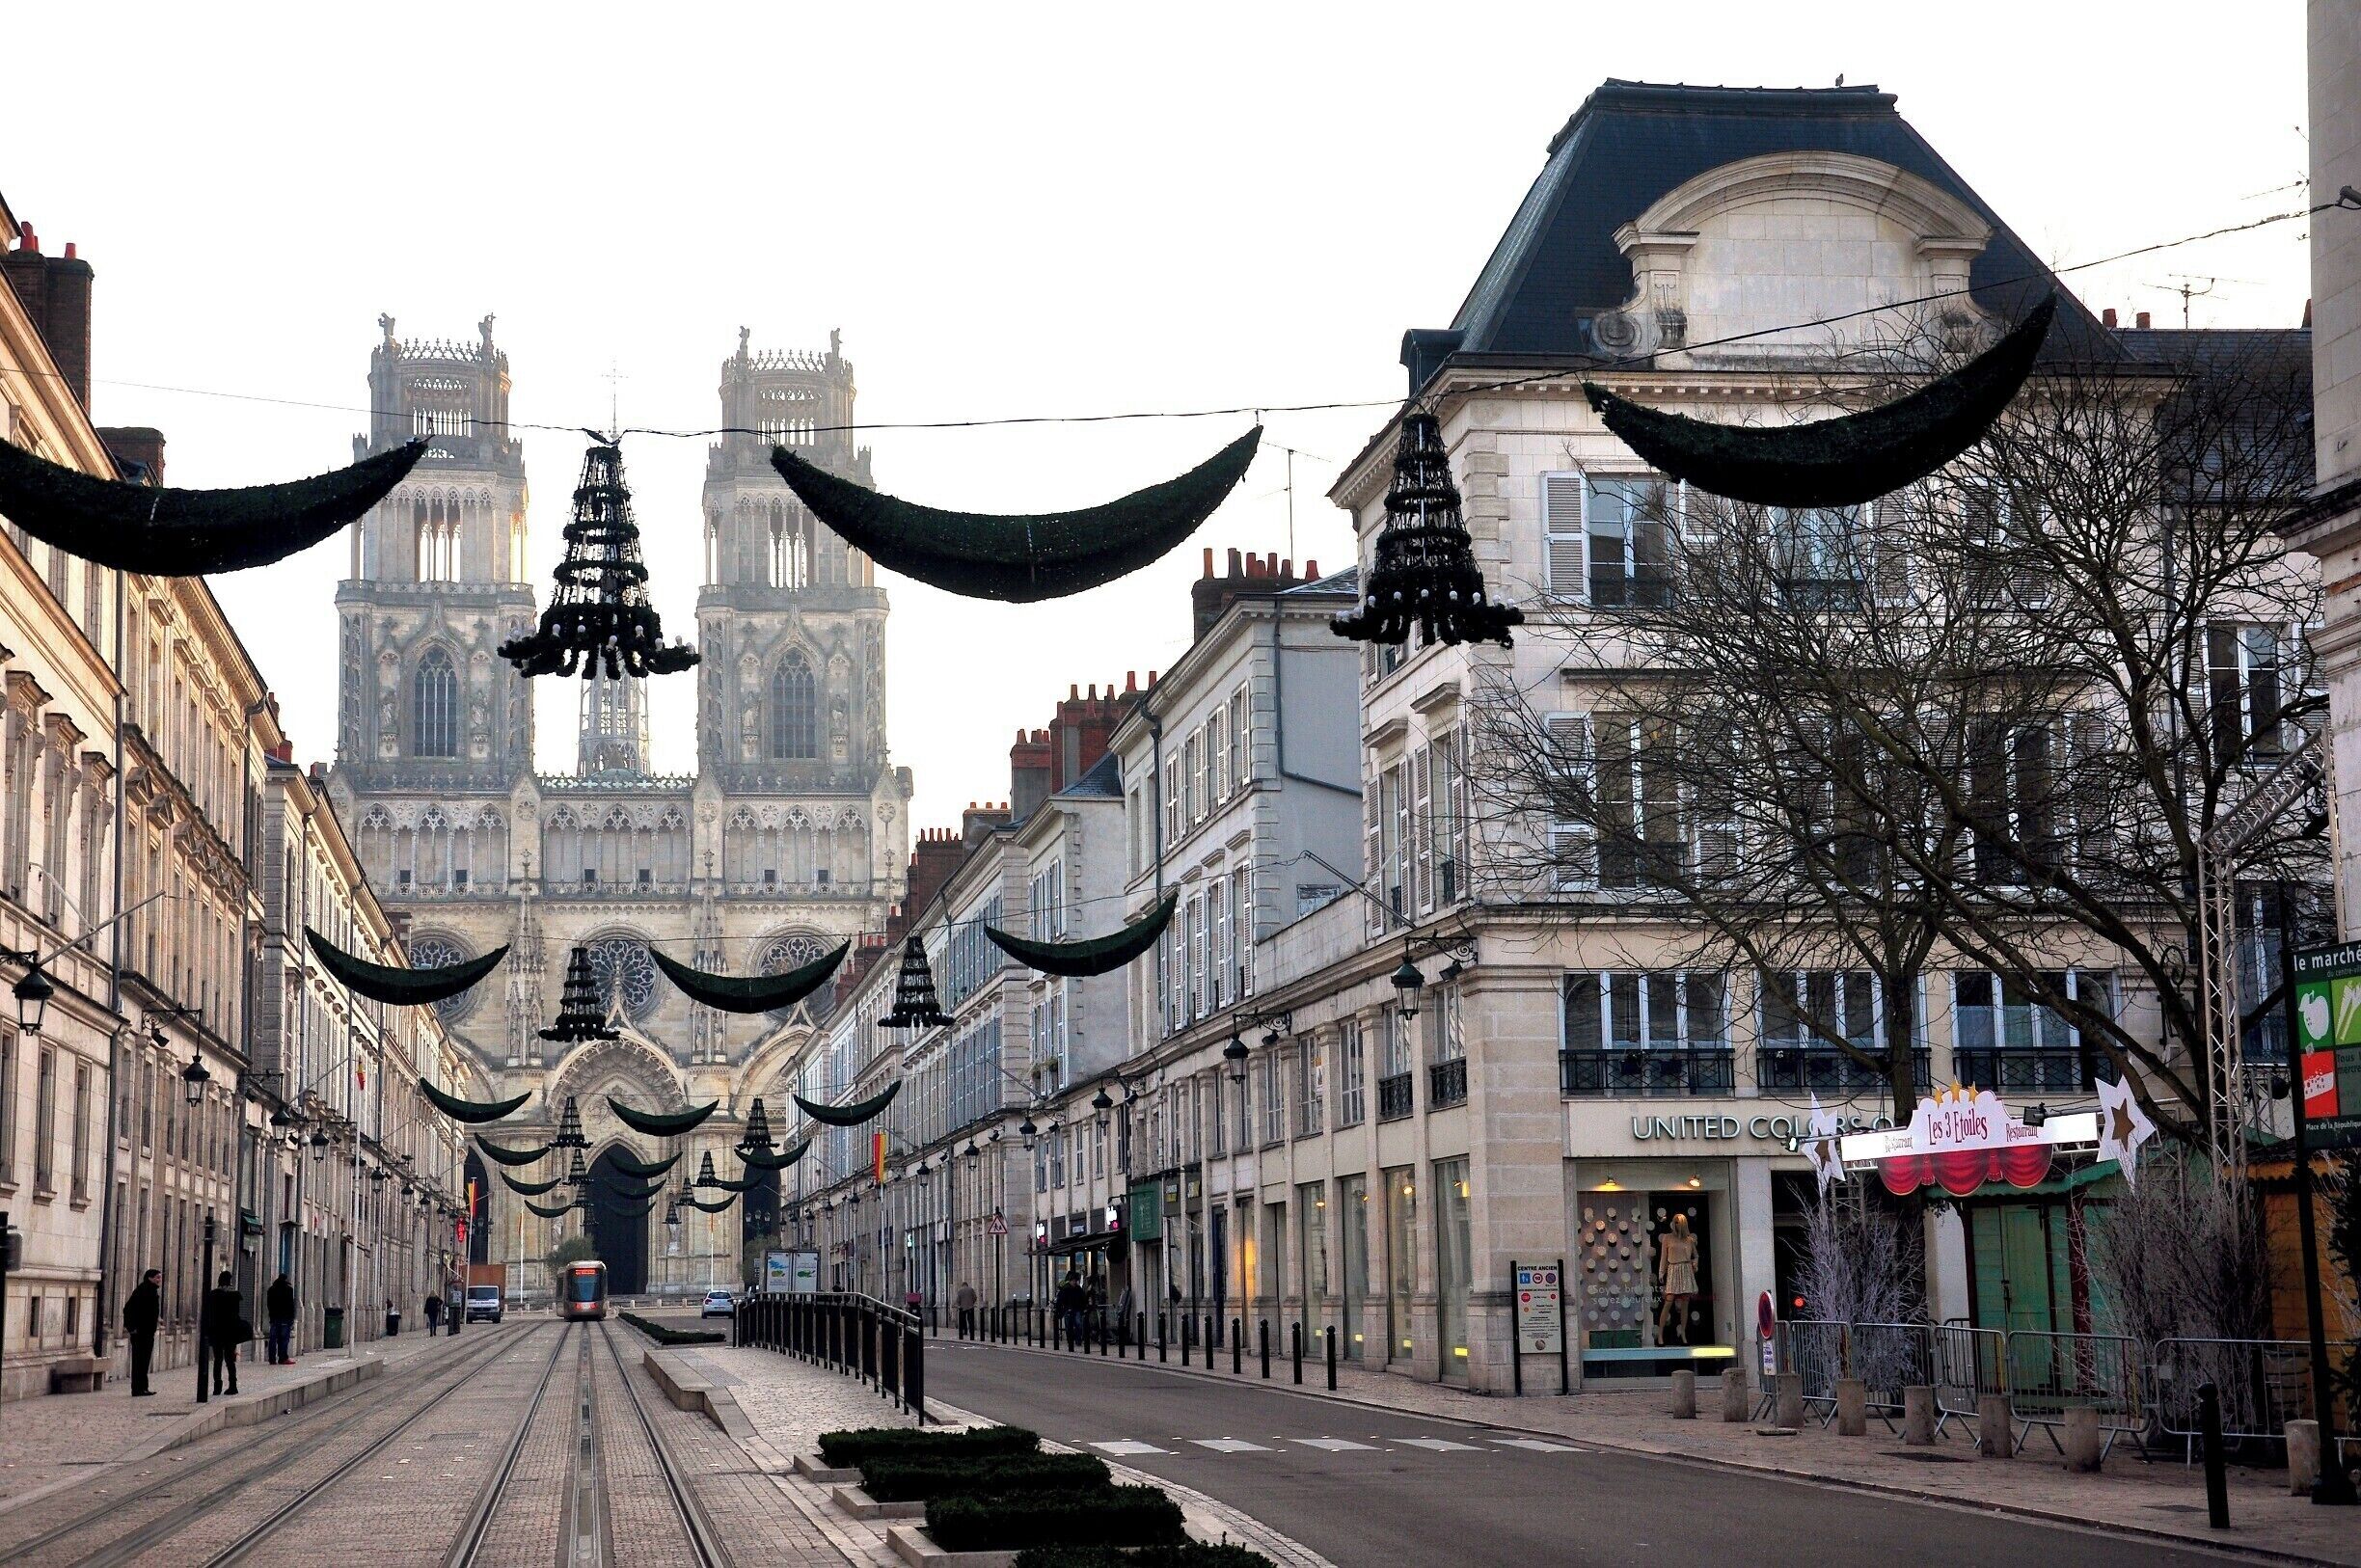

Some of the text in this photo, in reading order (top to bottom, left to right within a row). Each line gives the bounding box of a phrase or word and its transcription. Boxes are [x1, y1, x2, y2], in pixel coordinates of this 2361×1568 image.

[2293, 954, 2306, 972] le
[1632, 1115, 1741, 1140] UNITED
[1928, 1108, 1988, 1146] Les 3 Etoiles
